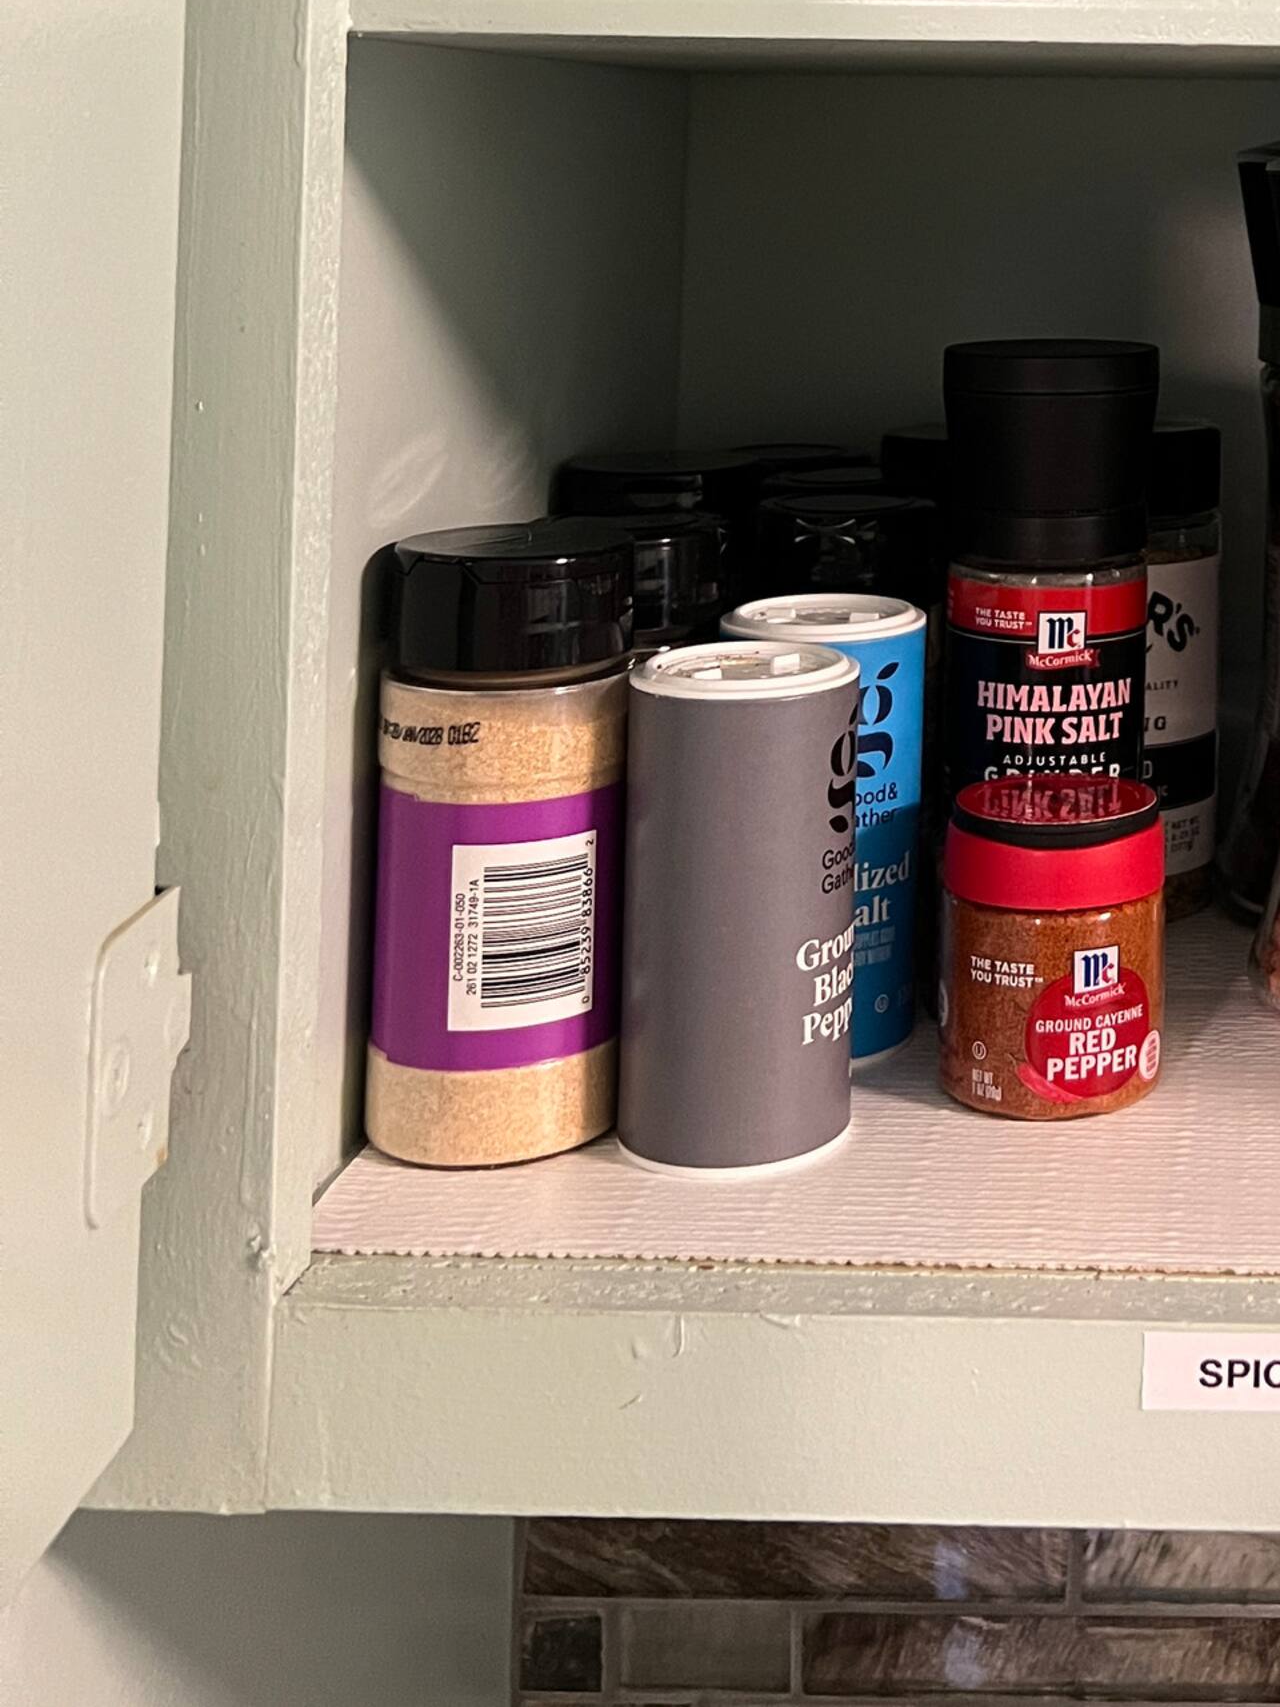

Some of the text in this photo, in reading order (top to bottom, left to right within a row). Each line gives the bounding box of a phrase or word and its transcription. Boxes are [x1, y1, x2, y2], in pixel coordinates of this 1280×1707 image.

[975, 607, 1026, 621] THE TASTE
[975, 616, 993, 627] YOU
[1027, 649, 1094, 668] McCormick
[976, 677, 1132, 714] HIMALAYAN
[1145, 679, 1179, 691] ALITY
[985, 712, 1056, 745] PINK
[1060, 711, 1124, 746] SALT
[1002, 751, 1107, 767] ADJUSTABLE
[581, 867, 593, 917] 83866
[854, 894, 892, 927] alt
[465, 879, 480, 995] 261 02 1272 31749-1A
[579, 926, 591, 974] 85239
[971, 956, 1035, 975] THE TASTE
[971, 970, 992, 983] YOU
[1064, 983, 1127, 1007] McCormick
[1035, 1004, 1144, 1033] GROUND CAYENNE
[1069, 1027, 1117, 1055] RED
[1046, 1044, 1137, 1082] PEPPER
